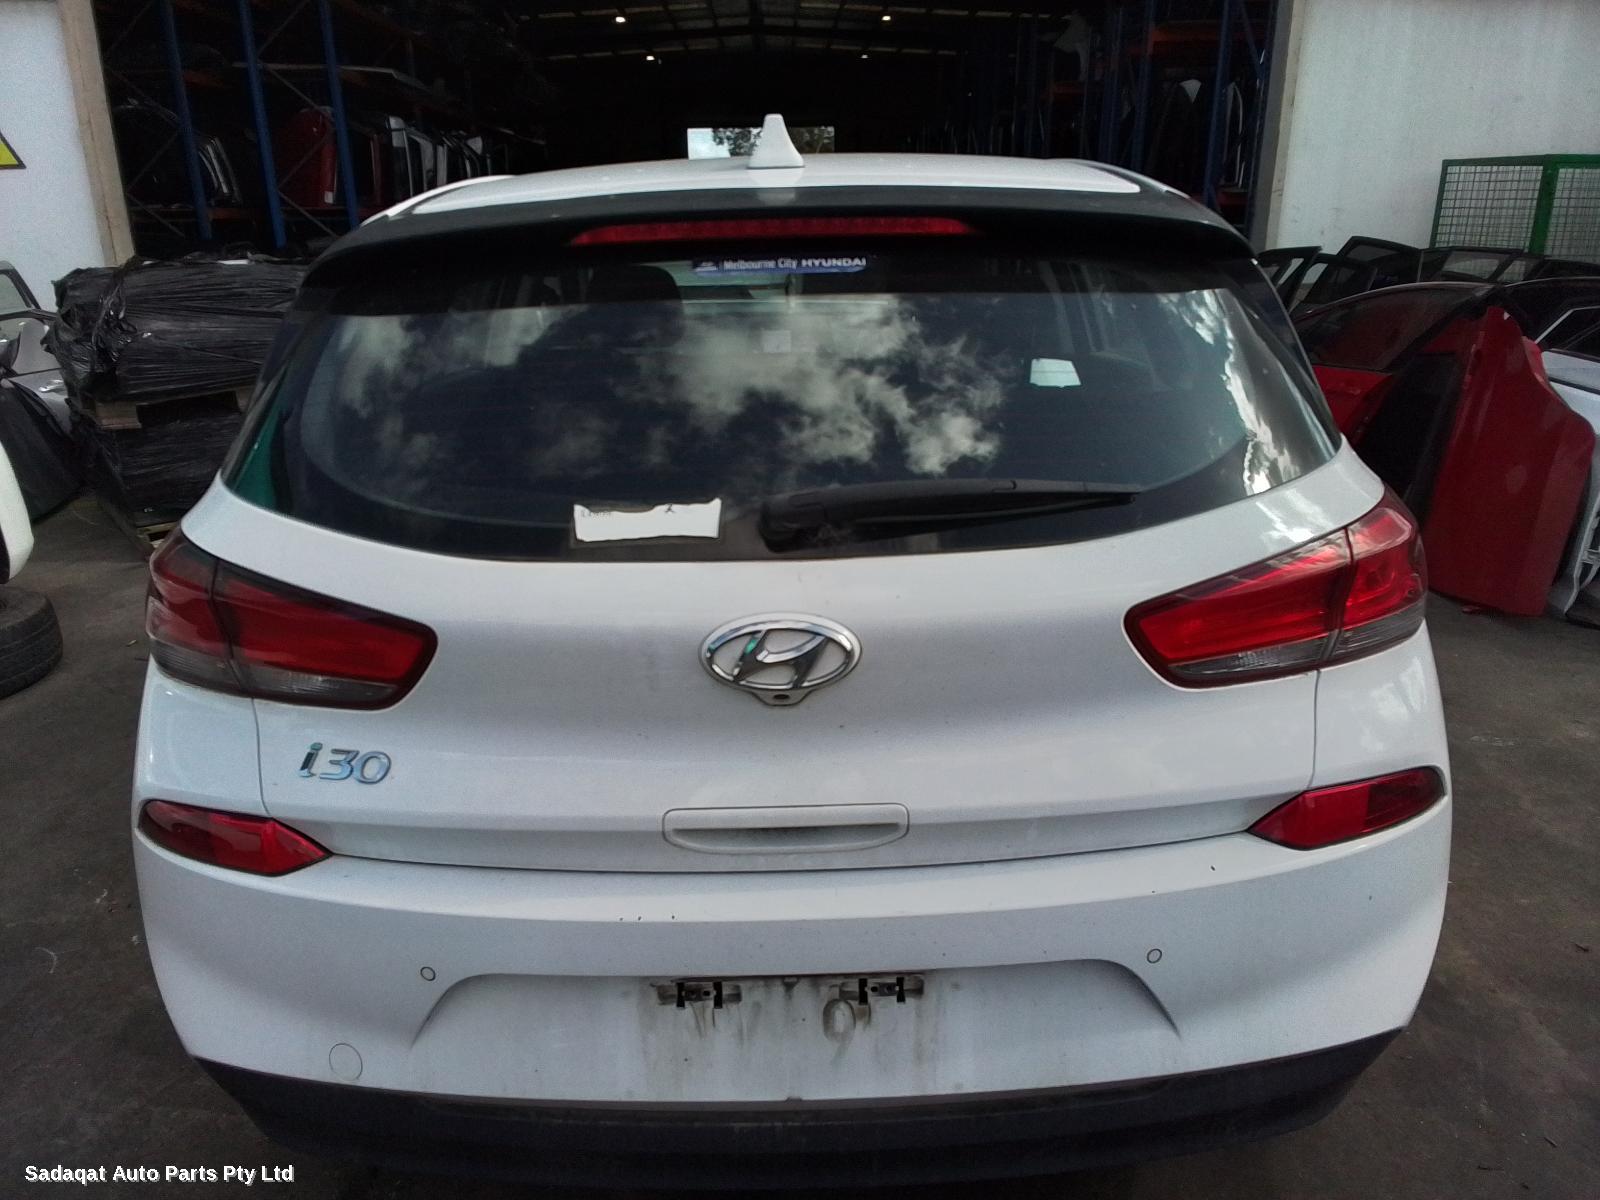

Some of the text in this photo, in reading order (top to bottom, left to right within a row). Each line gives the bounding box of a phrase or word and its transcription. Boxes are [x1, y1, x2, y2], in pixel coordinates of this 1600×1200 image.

[724, 257, 867, 270] Melbourne City HYUNDAI
[297, 742, 392, 785] i30
